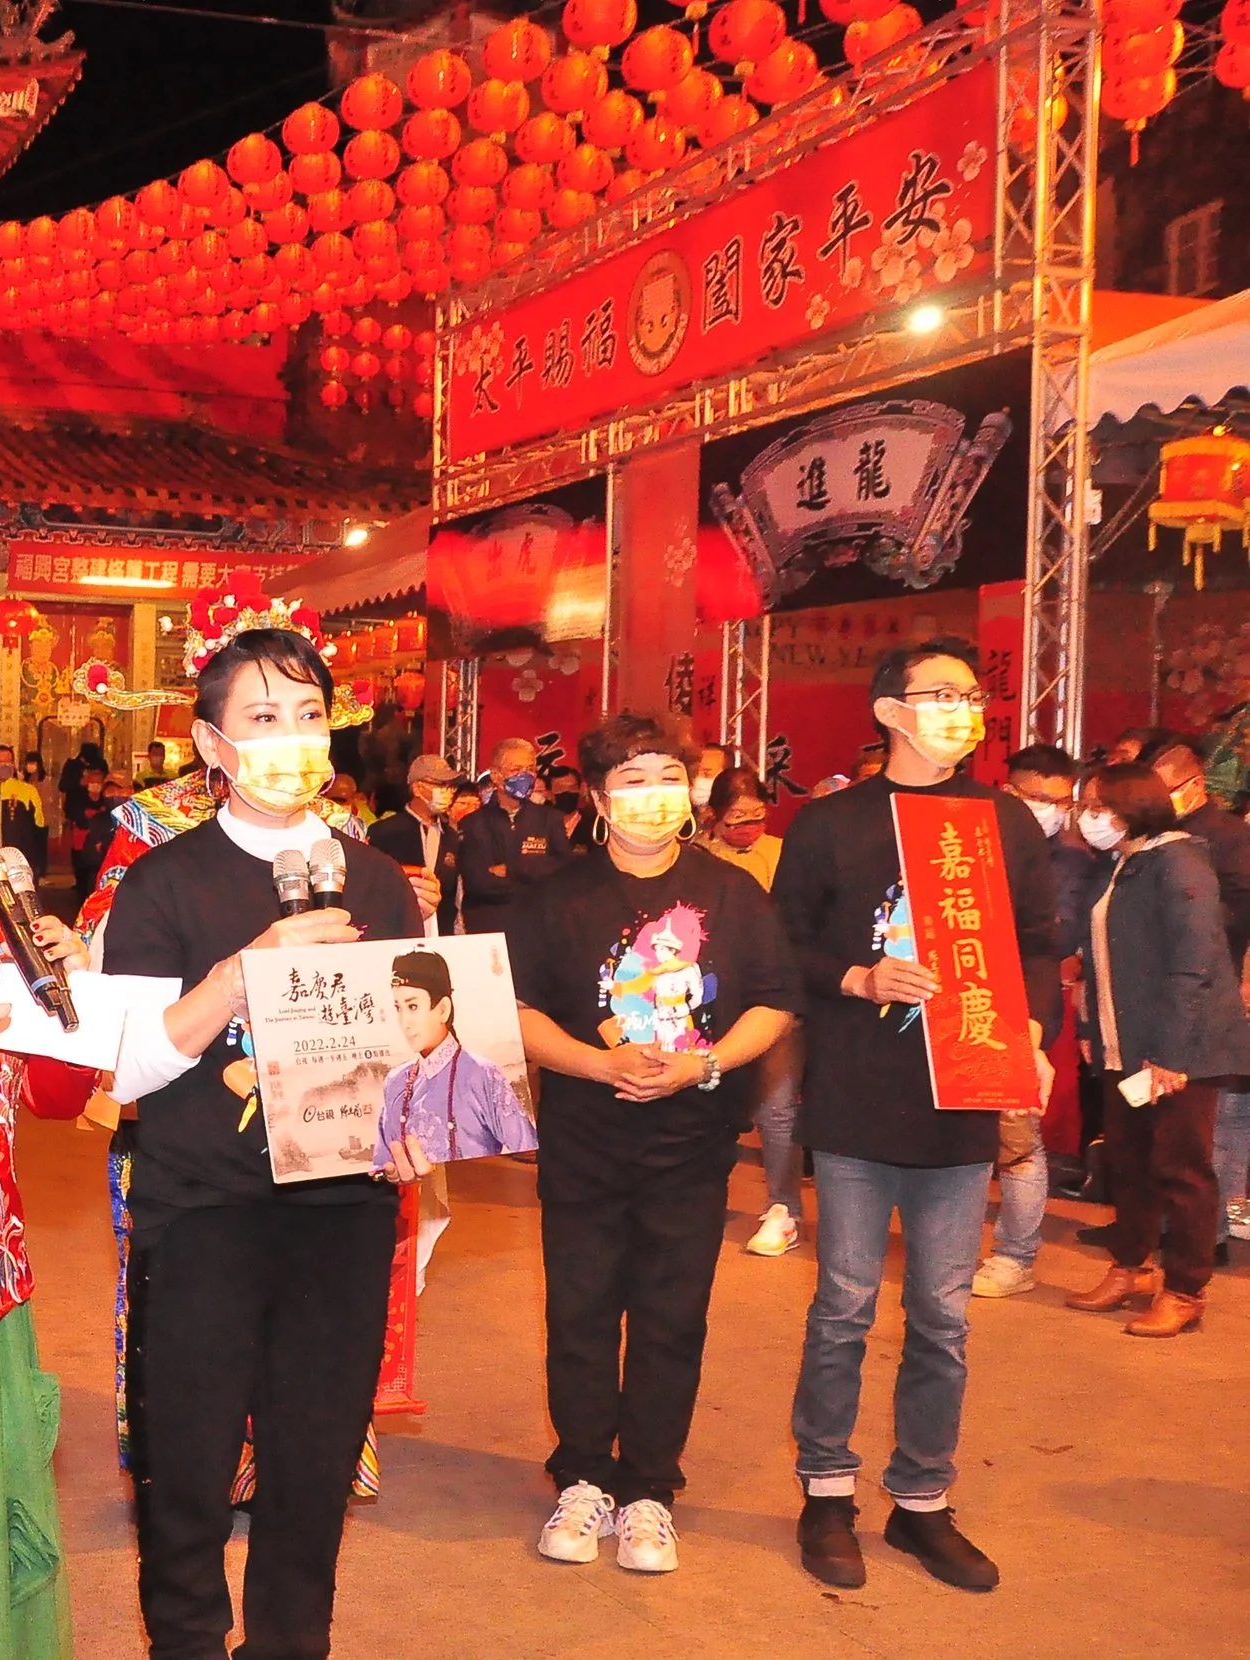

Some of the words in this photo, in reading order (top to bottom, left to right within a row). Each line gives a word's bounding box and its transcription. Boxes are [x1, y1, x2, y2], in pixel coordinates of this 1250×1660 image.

[470, 299, 618, 417] 太平賜福
[701, 148, 954, 334] 闔家平安
[293, 1035, 357, 1053] 2022.2.24
[930, 822, 1007, 1051] 嘉福同慶
